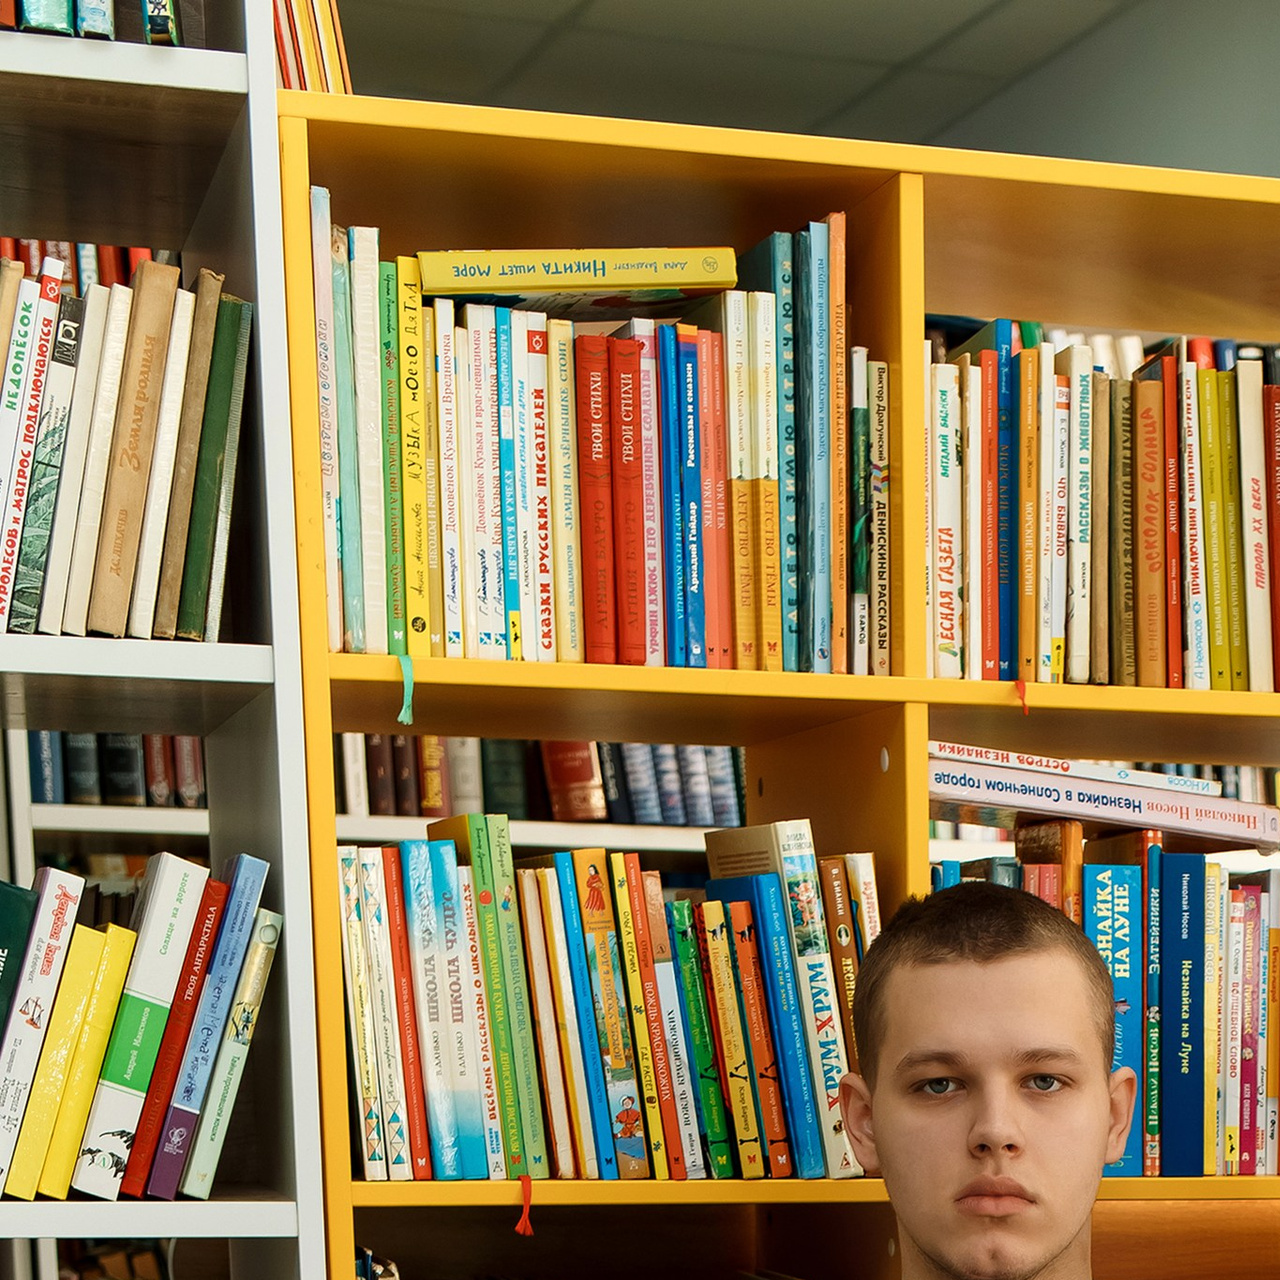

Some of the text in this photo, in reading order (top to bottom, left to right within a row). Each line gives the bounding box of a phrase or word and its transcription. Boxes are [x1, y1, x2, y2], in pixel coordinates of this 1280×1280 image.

[5, 301, 33, 410] НЕДОПЁСОК
[23, 317, 53, 443] ПОДКЛЮЧАЮТСЯ
[442, 334, 454, 403] Вреднючка
[472, 329, 485, 418] враг-невидимка
[120, 405, 144, 472] Земля
[444, 418, 456, 461] Кузька
[474, 431, 486, 470] Кузька
[558, 340, 573, 530] ЗЕМЛЯ НА ЗЁРНЫШКЕ СТОИТ
[590, 372, 603, 460] ТВОИ СТИХИ
[685, 363, 696, 467] Рассказы и сказки
[875, 367, 886, 461] Виктор Драгунский
[1078, 374, 1090, 543] РАССКАЗЫ О ЖИВОТНЫХ
[445, 463, 456, 532] Домовёнок
[475, 472, 488, 533] Домовёнок
[504, 471, 514, 511] КУЗЬКА
[531, 388, 554, 649] СКАЗКИ РУССКИХ ПИСАТЕЛЕЙ
[640, 369, 660, 654] УРФИН ДЖЮС И ЕГО ДЕРЕВЯННЫЕ СОЛДАТЫ
[1055, 477, 1066, 557] ЧТО БЫВАЛО
[1140, 408, 1161, 572] ОСКОЛОК СОЛНЦА
[1252, 478, 1262, 510] ВЕКА
[506, 526, 518, 580] БАБЫ-ЯГИ
[688, 502, 699, 593] Аркадий Гайдар
[876, 500, 888, 650] ДЕНИСКИНЫ РАССКАЗЫ
[937, 527, 958, 656] ЛЕСНАЯ ГАЗЕТА
[1253, 542, 1265, 589] ПАРОЛЬ
[934, 773, 1142, 814] Незнайка в Солнечном городе
[1147, 802, 1258, 829] Николай Носов
[183, 906, 217, 1000] ТВОЯ АНТАРКТИДА
[442, 892, 464, 1023] ШКОЛА ЧУДЕС
[644, 981, 672, 1101] ВОЖДЬ КРАСНОКОЖИХ
